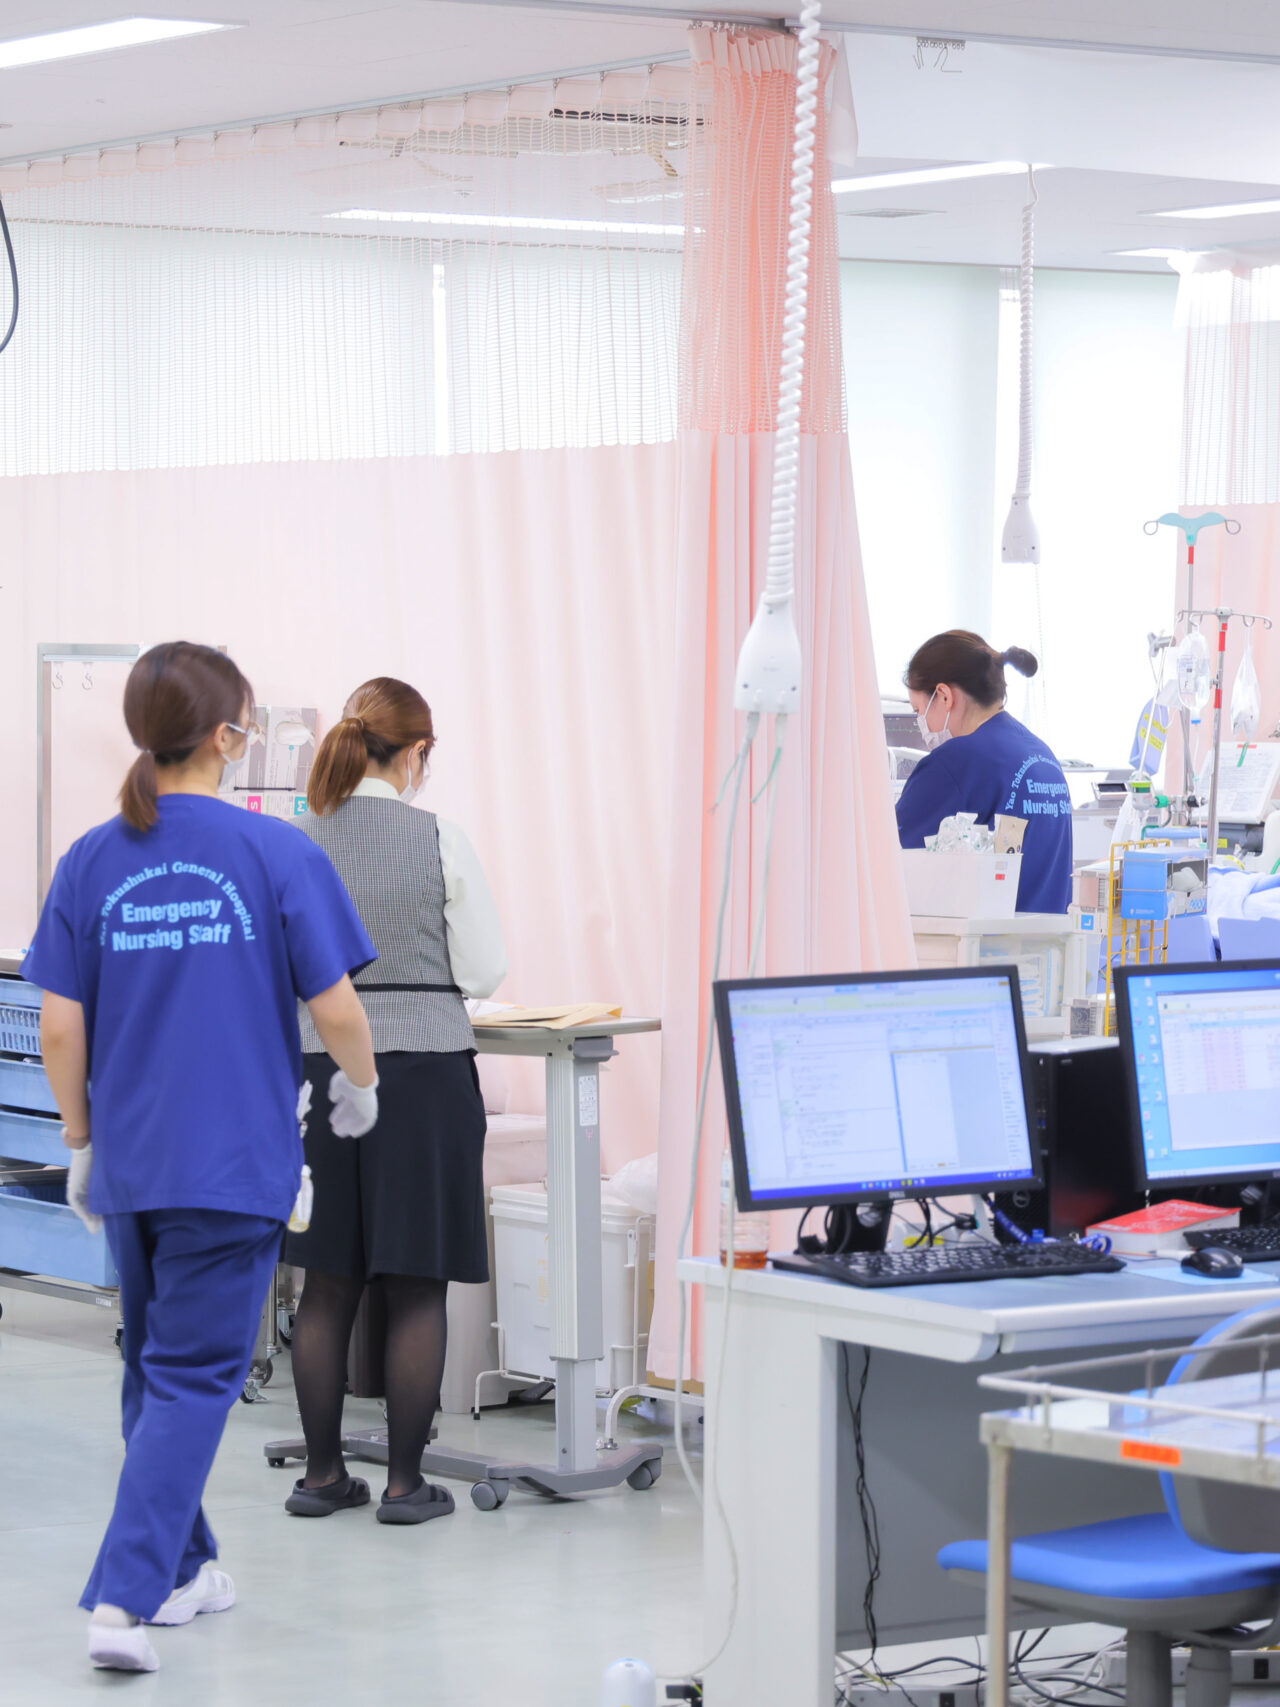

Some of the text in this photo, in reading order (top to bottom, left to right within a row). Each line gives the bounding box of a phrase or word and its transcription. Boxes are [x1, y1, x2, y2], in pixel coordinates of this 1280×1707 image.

[1026, 778, 1069, 797] Emergency
[250, 800, 259, 811] S
[297, 801, 305, 811] M
[1005, 791, 1016, 811] Yao
[1023, 799, 1058, 817] Nursing
[100, 862, 168, 918] Tokushukai
[171, 861, 224, 885] General
[221, 880, 257, 942] Hospital
[121, 898, 222, 923] Emergency
[112, 928, 184, 952] Nursing
